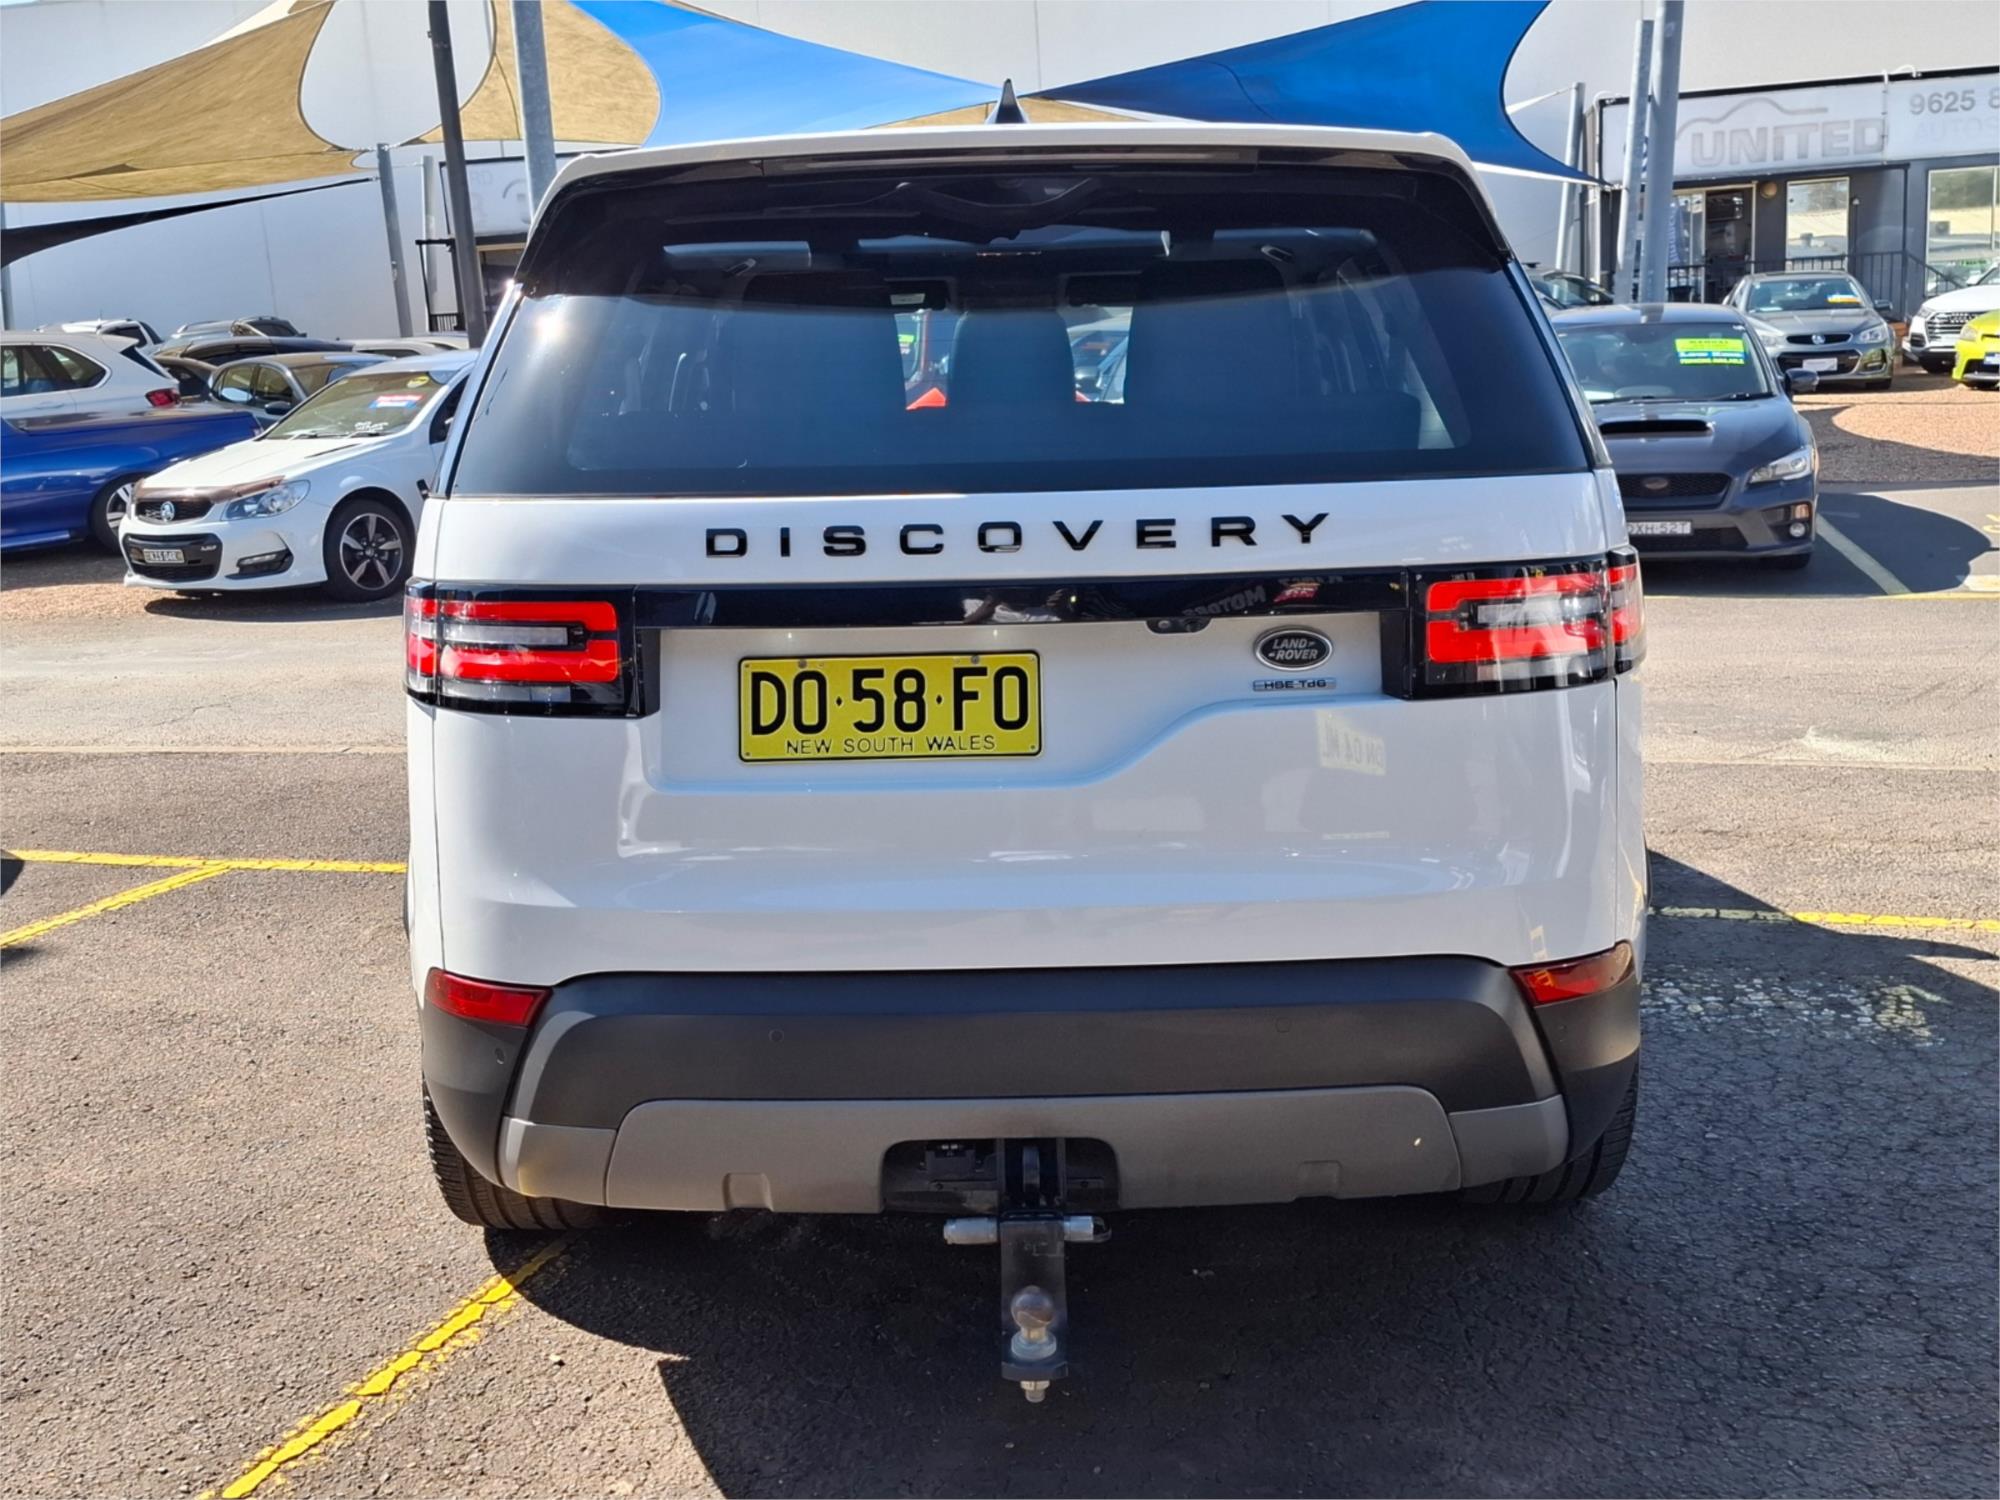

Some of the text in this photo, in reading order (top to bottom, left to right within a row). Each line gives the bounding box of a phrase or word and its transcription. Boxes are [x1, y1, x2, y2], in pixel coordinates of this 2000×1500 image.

[1909, 89, 1977, 116] 9625
[1691, 118, 1885, 168] UNITED
[705, 512, 1330, 558] DISCOVERY
[1271, 638, 1308, 649] LAND
[1275, 649, 1318, 660] ROVER
[1264, 680, 1294, 689] HSE
[786, 734, 997, 754] NEW SOUTH WALES
